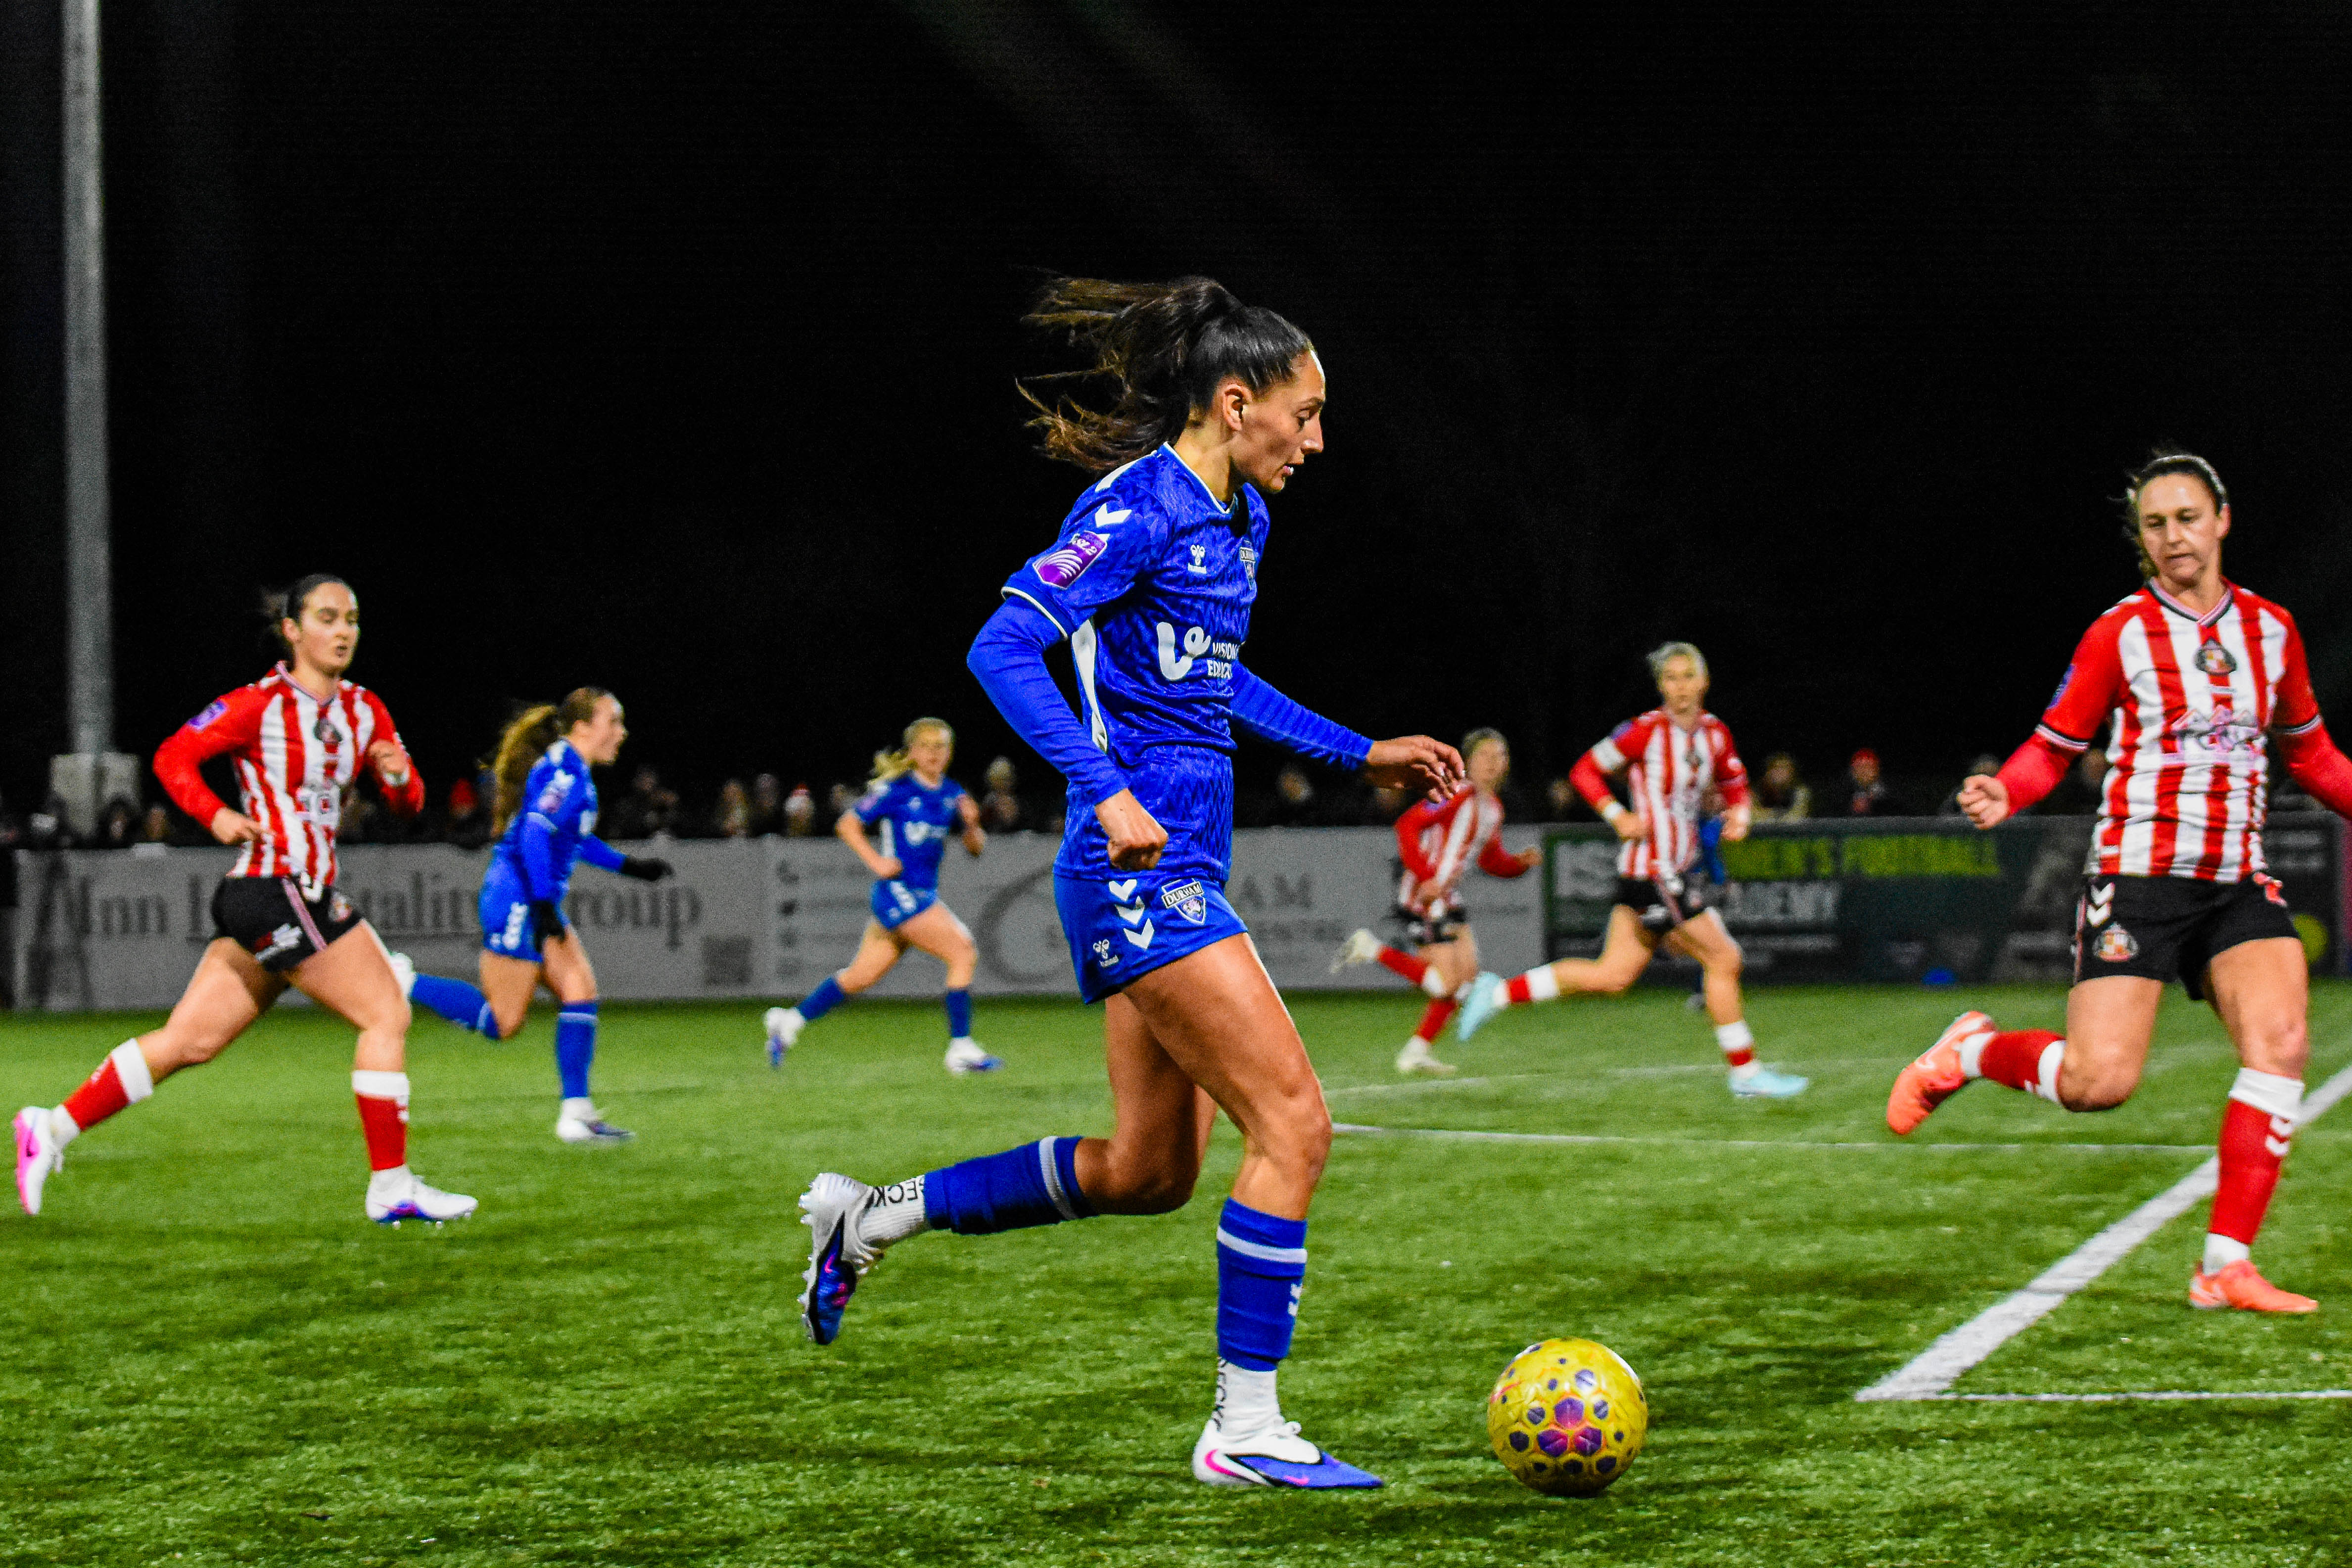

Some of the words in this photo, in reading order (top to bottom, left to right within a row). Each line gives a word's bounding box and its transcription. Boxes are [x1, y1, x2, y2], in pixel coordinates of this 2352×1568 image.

[1212, 642, 1237, 659] VISION
[1207, 659, 1232, 679] EDUCA
[1165, 884, 1202, 905] DURHAM
[567, 888, 702, 950] roup
[865, 1178, 924, 1208] ECK
